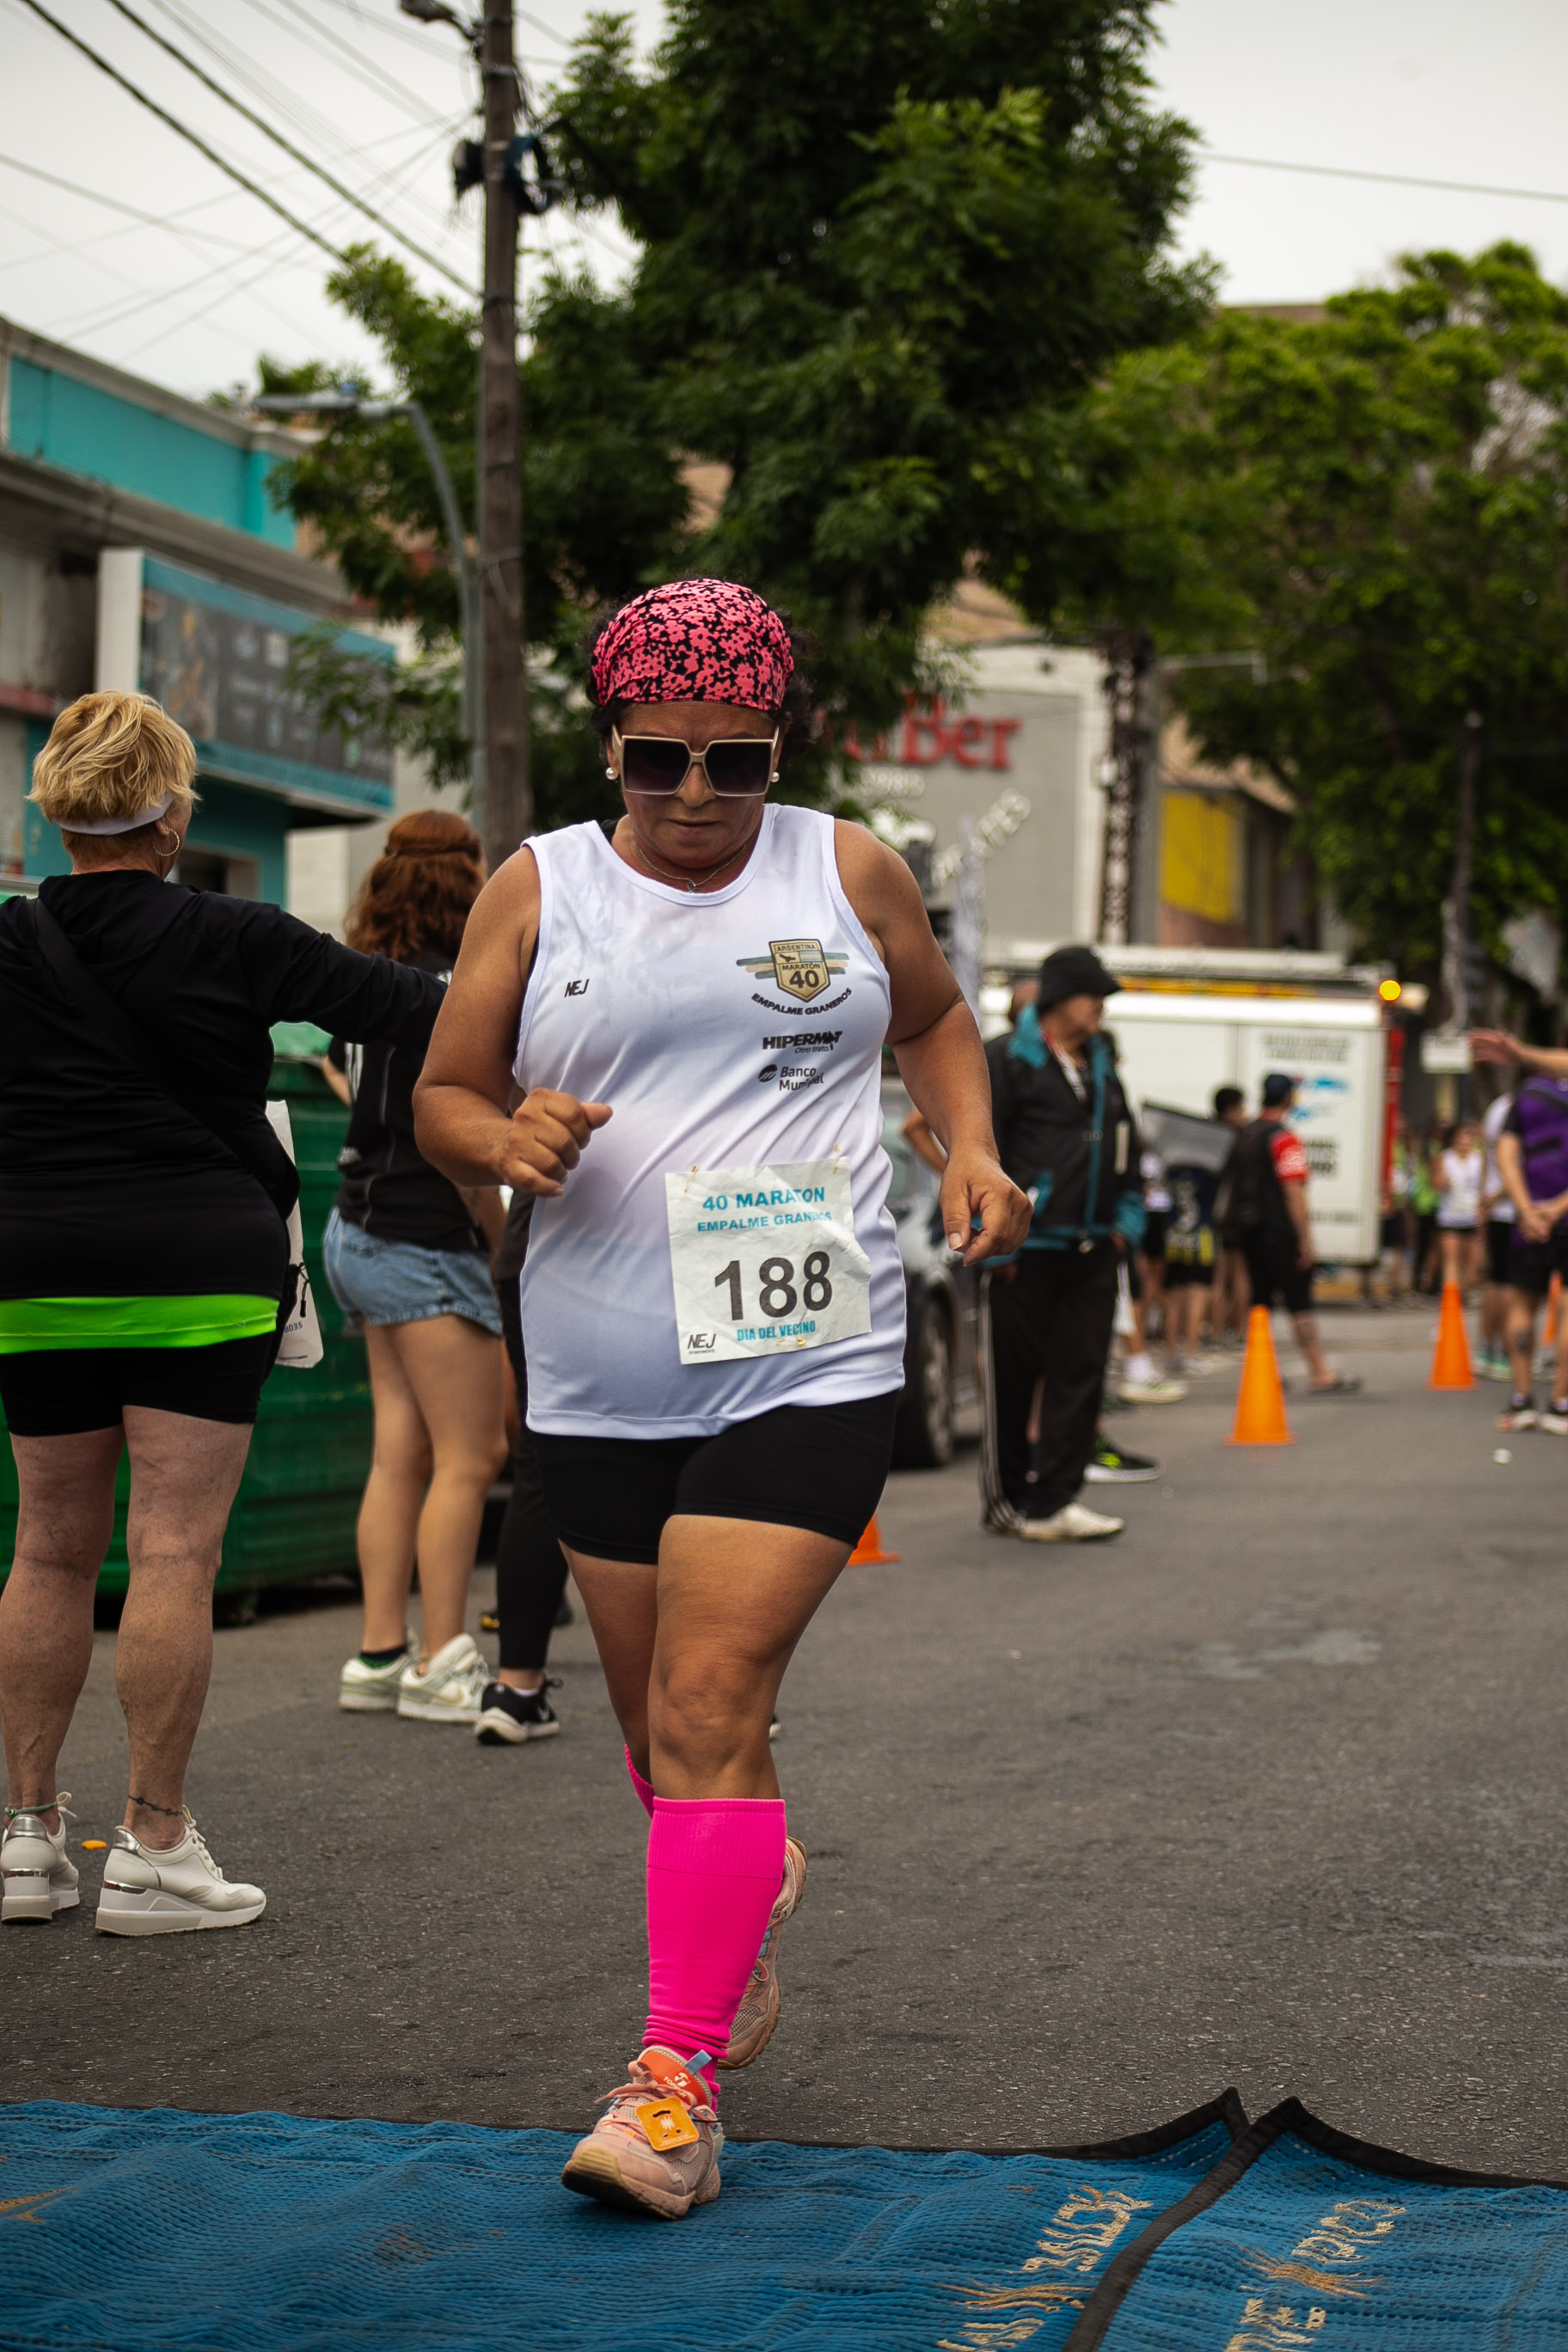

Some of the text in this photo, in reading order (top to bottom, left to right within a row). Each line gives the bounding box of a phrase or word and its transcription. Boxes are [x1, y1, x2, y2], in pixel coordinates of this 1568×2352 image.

[564, 978, 590, 998] NEJ
[789, 970, 820, 989] 40
[751, 987, 852, 1015] EMPALME GRANEROS
[781, 1067, 817, 1078] Banco
[702, 1186, 825, 1211] 40 MARATON
[697, 1216, 769, 1232] EMPALME
[714, 1251, 833, 1321] 188
[737, 1320, 816, 1341] DIA DEL VECINO
[688, 1333, 717, 1350] NEJ
